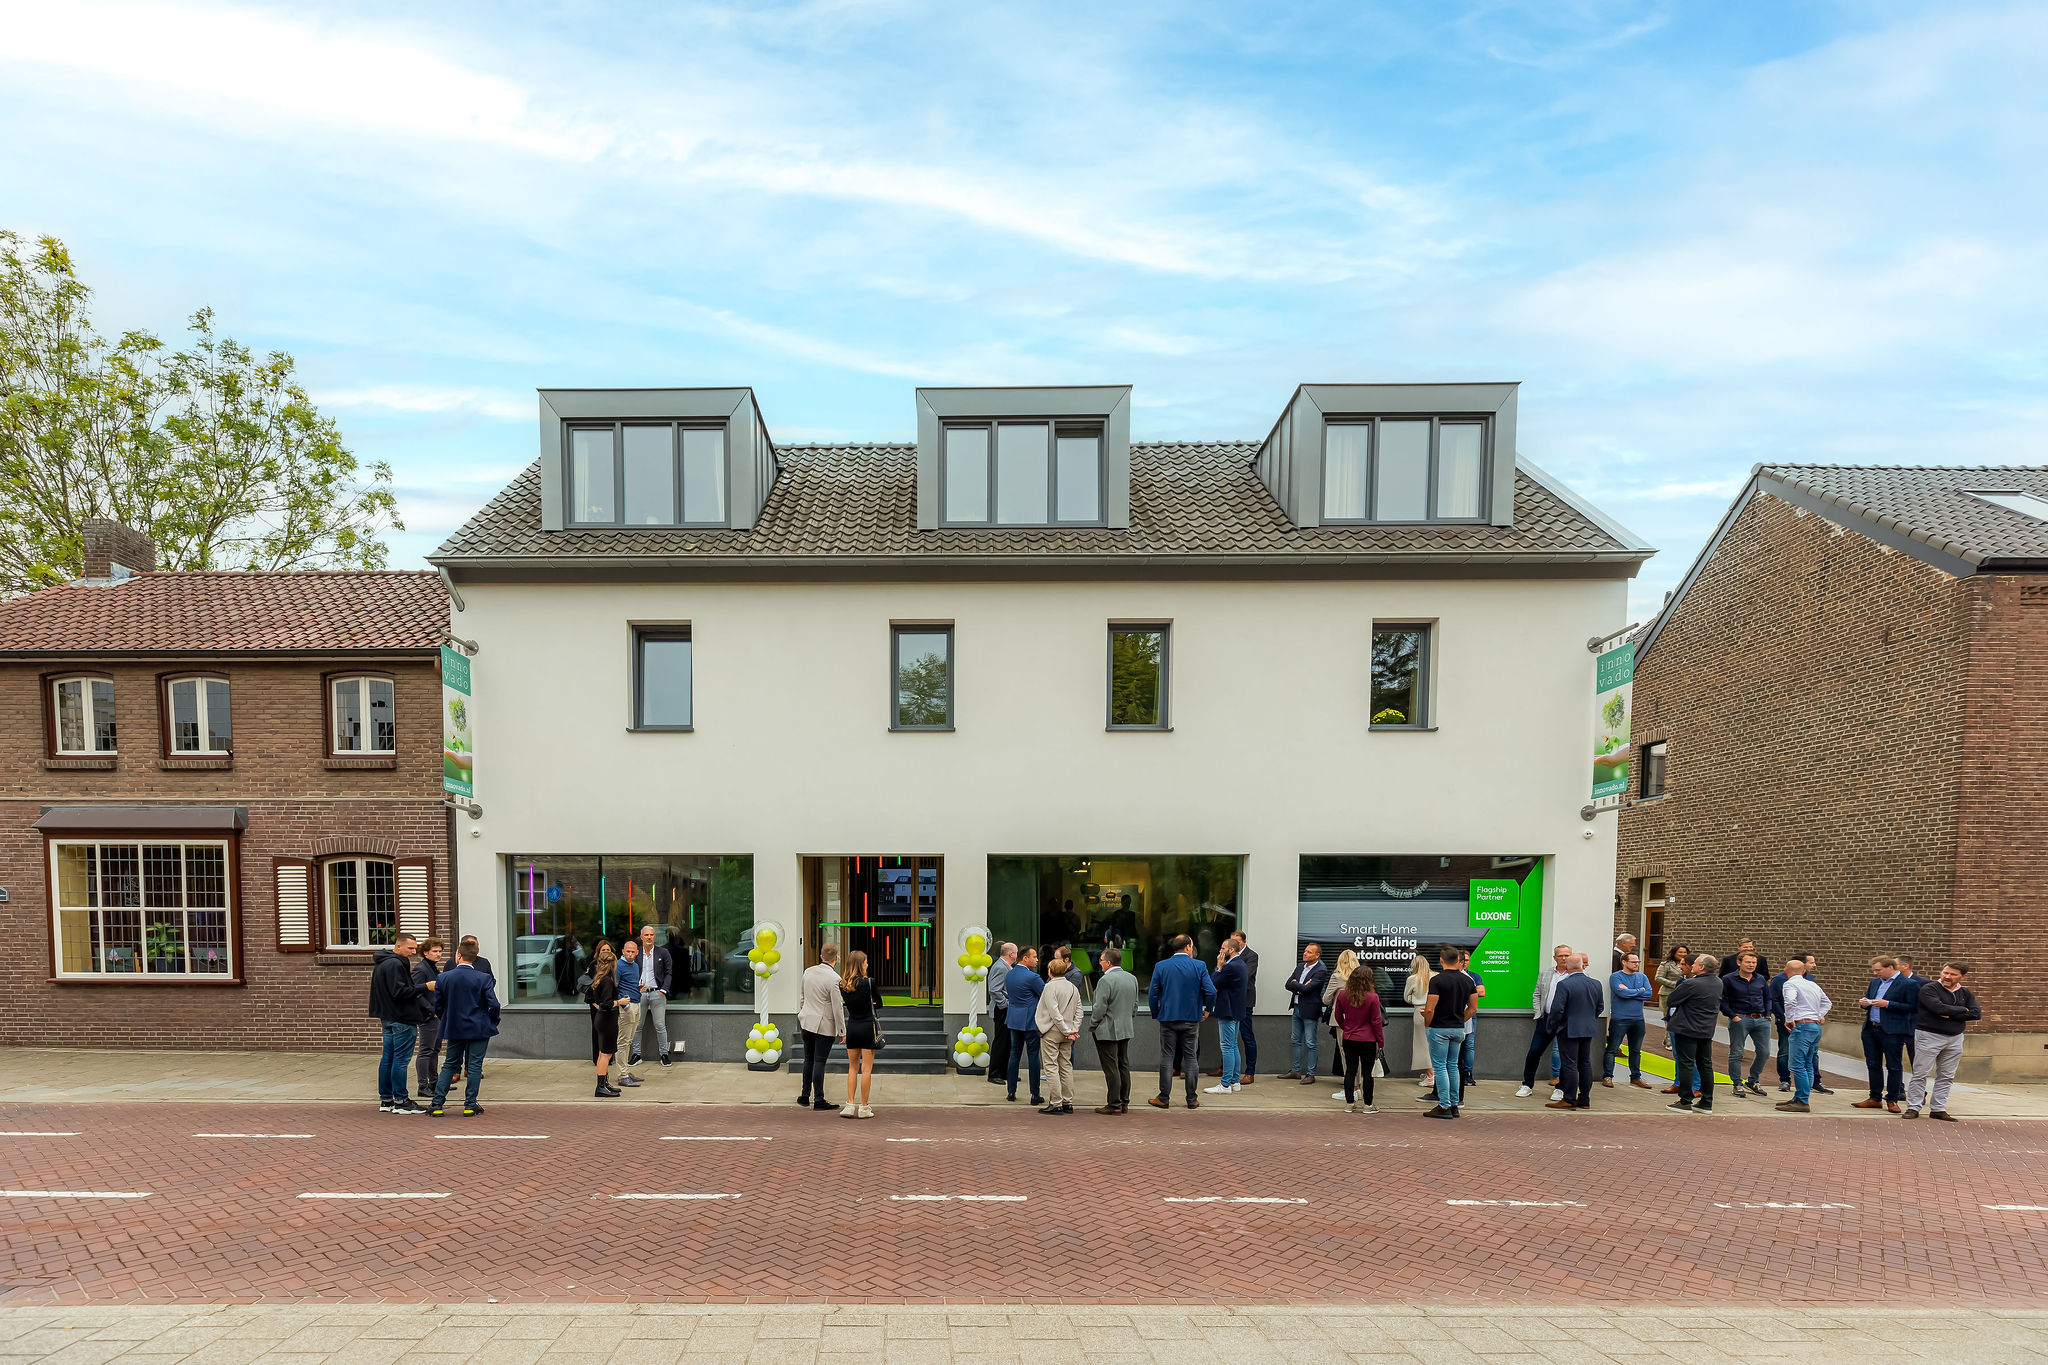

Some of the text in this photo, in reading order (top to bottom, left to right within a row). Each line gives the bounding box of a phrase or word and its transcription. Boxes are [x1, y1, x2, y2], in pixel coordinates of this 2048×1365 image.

[443, 652, 469, 676] inno
[1600, 652, 1631, 673] inno
[443, 670, 469, 690] vado
[1599, 668, 1631, 688] vado
[1594, 780, 1625, 795] innovado.nl
[1476, 886, 1508, 894] Flagship
[1475, 911, 1512, 921] LOXONE
[1340, 923, 1418, 934] Smart Home
[1353, 936, 1417, 950] & Building
[1356, 950, 1417, 960] utomation
